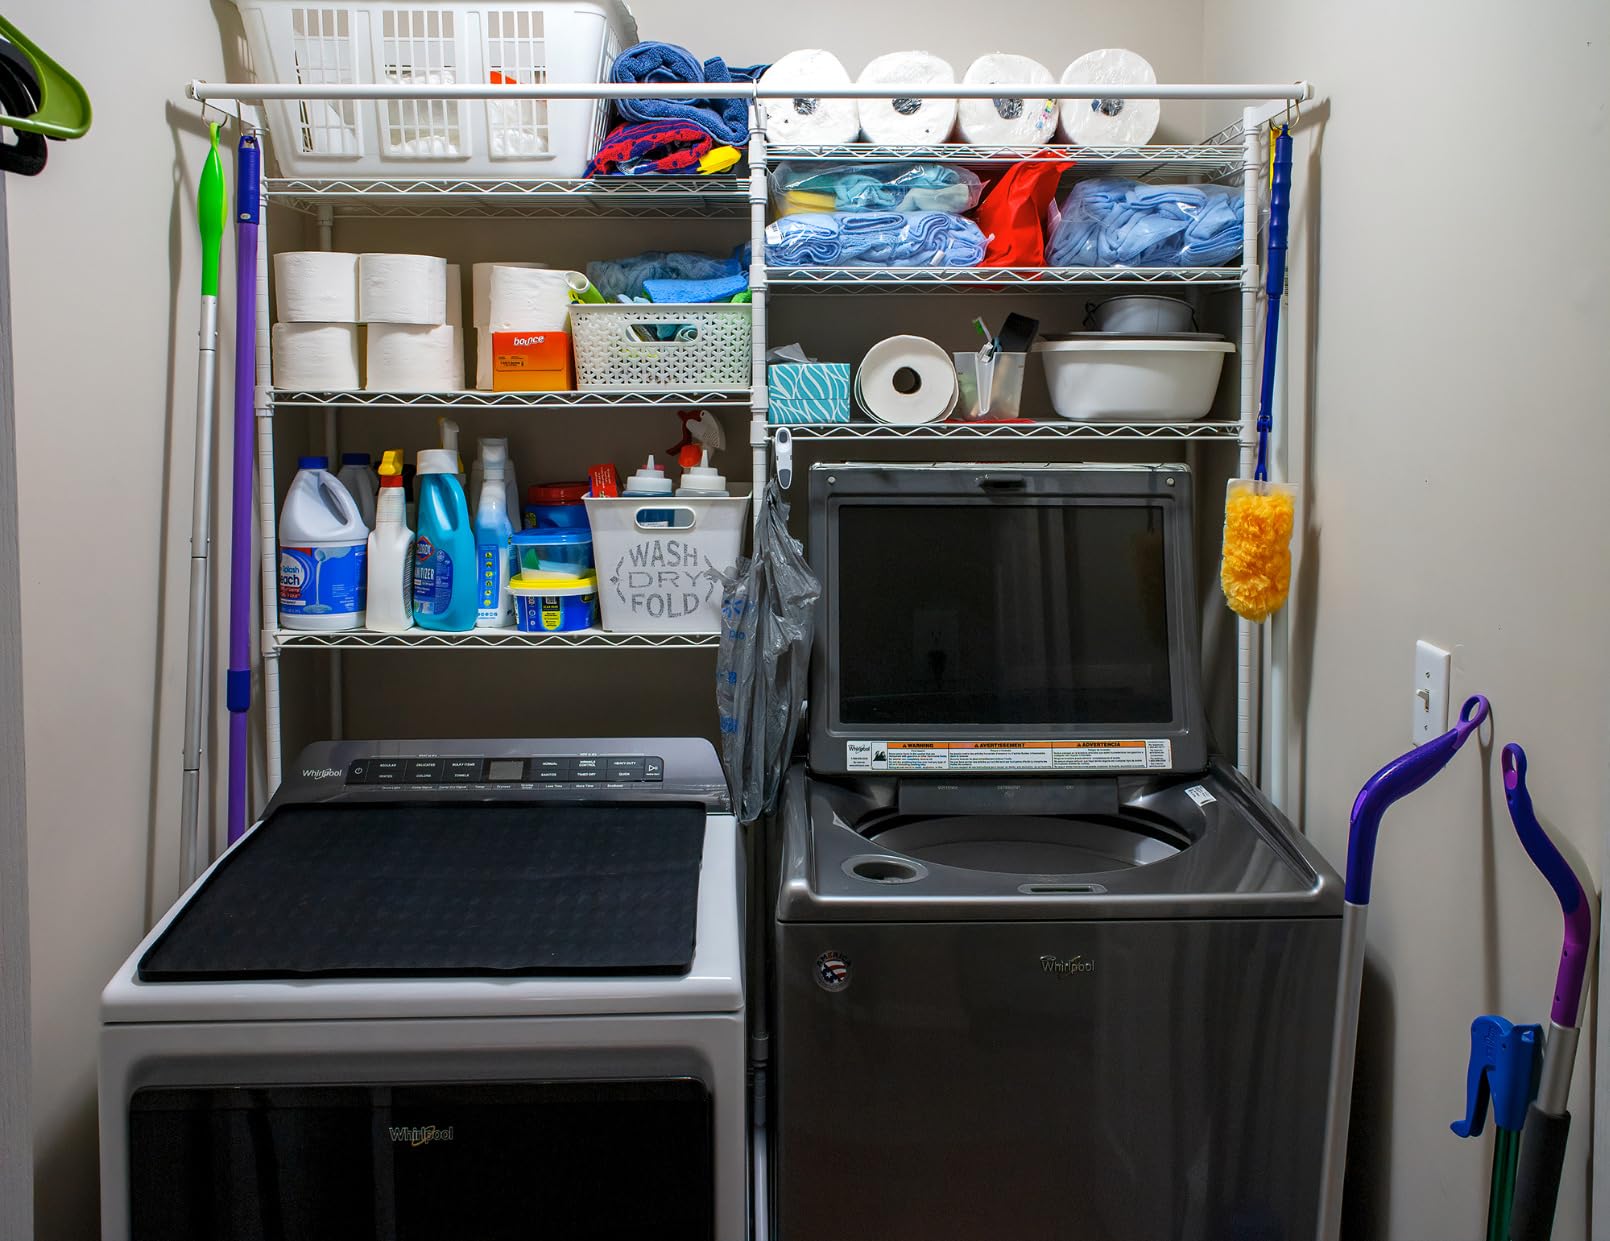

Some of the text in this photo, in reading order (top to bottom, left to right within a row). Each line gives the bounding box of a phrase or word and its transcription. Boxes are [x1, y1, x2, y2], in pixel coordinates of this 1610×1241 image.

[513, 335, 545, 346] bounce
[629, 540, 698, 567] WASH
[280, 574, 300, 585] each
[628, 571, 704, 588] DRY
[631, 593, 700, 618] FOLD
[848, 744, 871, 754] Whirlpool
[302, 768, 343, 780] Whirlpool
[1040, 955, 1097, 974] Whirlpool
[388, 1125, 453, 1146] Whirlpool
